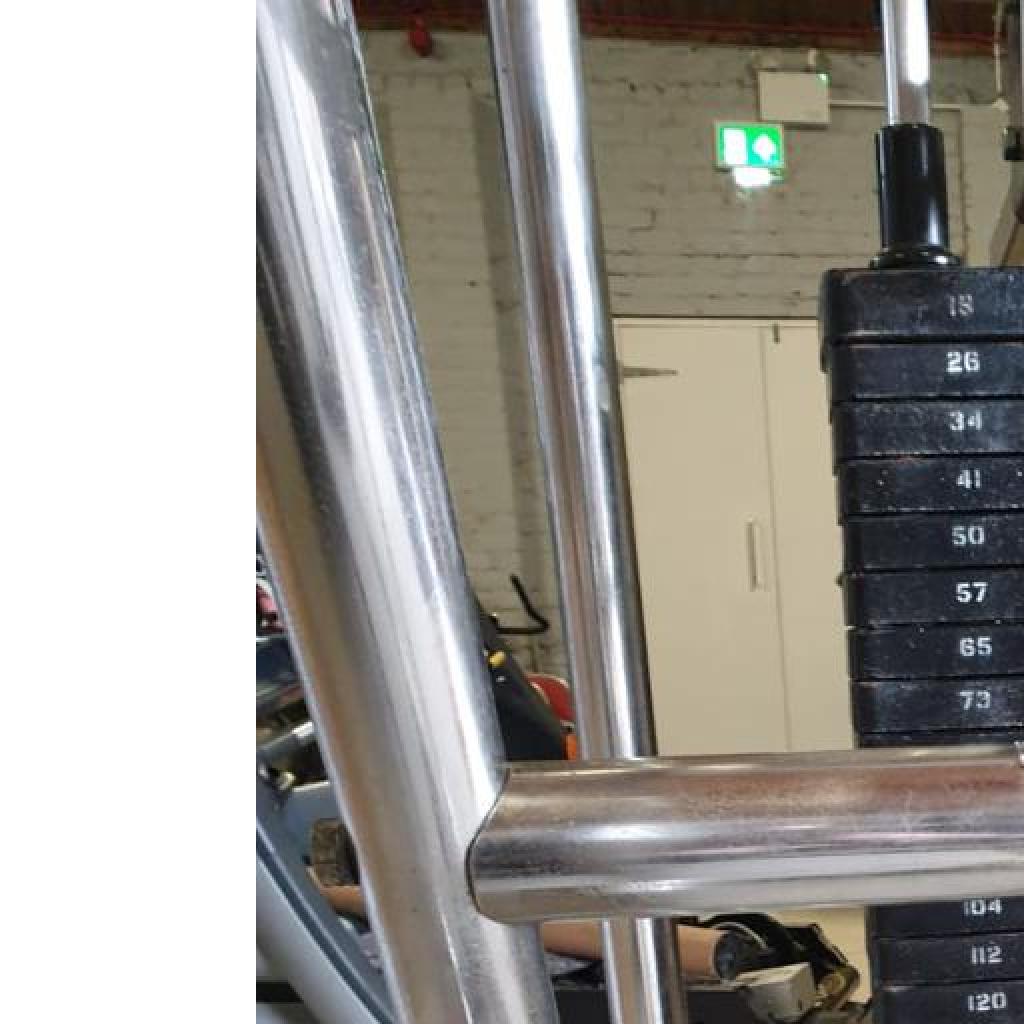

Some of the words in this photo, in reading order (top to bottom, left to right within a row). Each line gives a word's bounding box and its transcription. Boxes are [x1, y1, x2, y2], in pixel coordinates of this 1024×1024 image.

[946, 351, 979, 373] 26
[949, 410, 983, 432] 34
[956, 469, 981, 489] 41
[952, 526, 985, 546] 50
[955, 582, 988, 603] 57
[959, 636, 992, 657] 65
[959, 690, 991, 710] 73
[964, 898, 1002, 916] 104
[972, 946, 1002, 964] 112
[968, 992, 1006, 1011] 120
